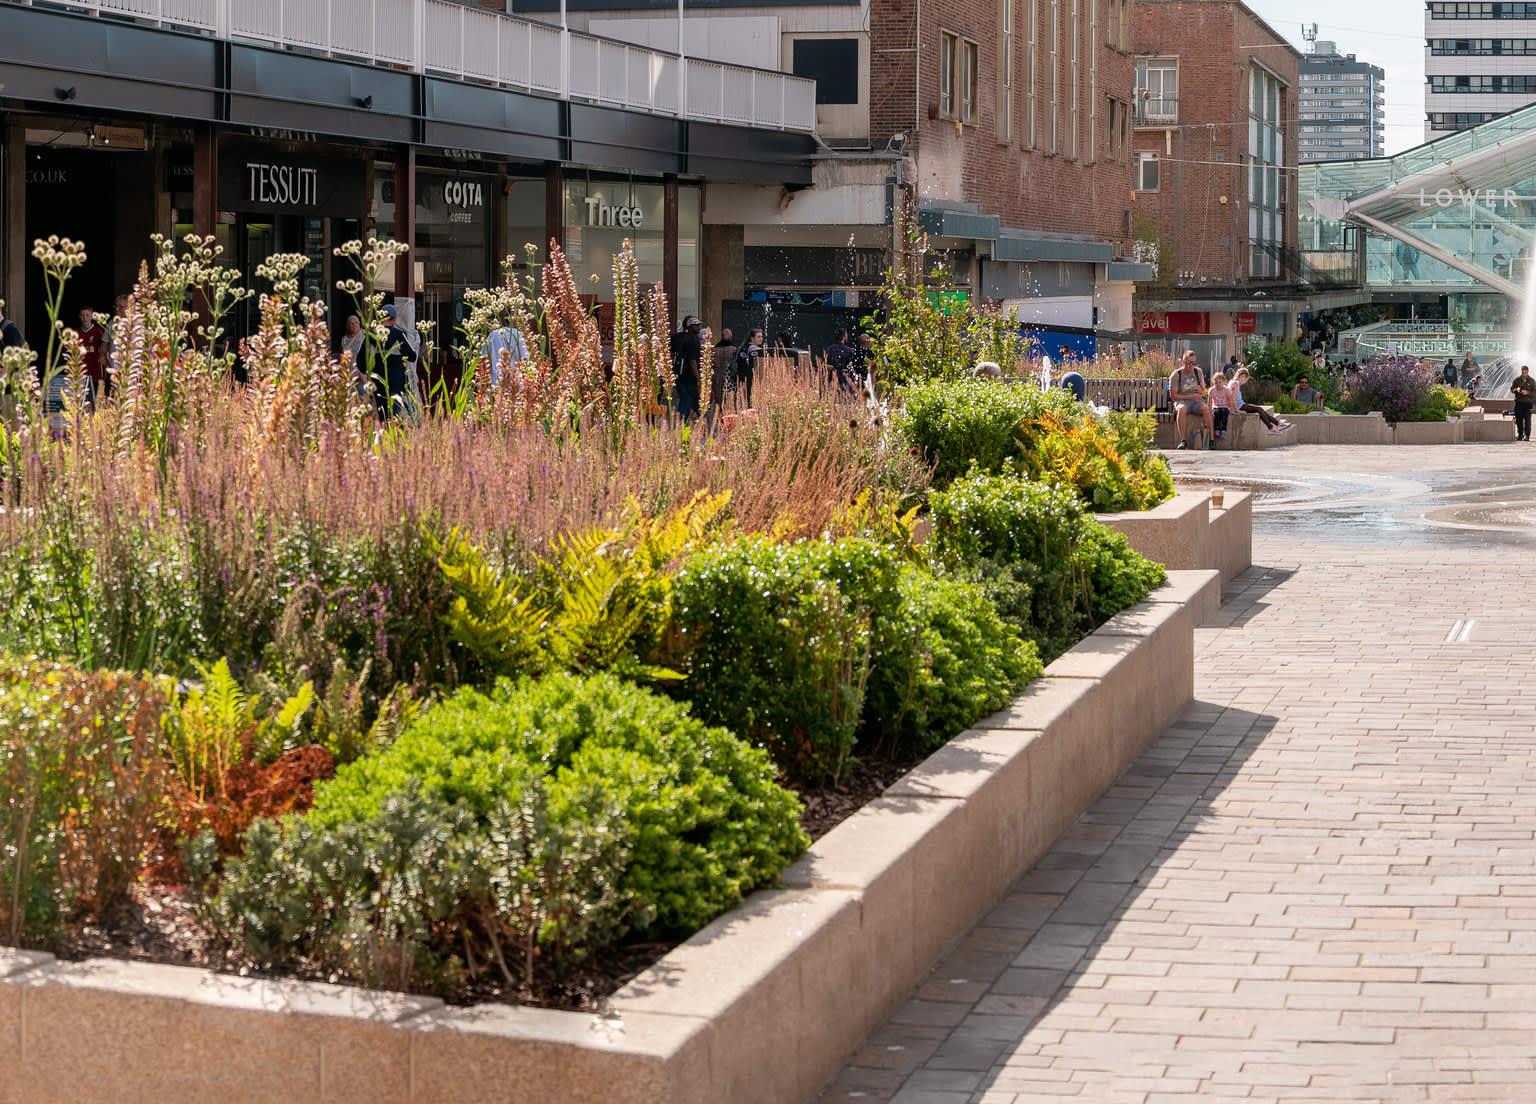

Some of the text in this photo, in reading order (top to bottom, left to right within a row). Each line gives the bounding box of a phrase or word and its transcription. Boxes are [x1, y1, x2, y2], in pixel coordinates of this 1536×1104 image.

[246, 162, 318, 206] TESSUTI
[444, 180, 483, 209] COSTA
[1419, 187, 1519, 209] LOWER
[584, 196, 645, 229] Three
[1141, 314, 1169, 330] avel
